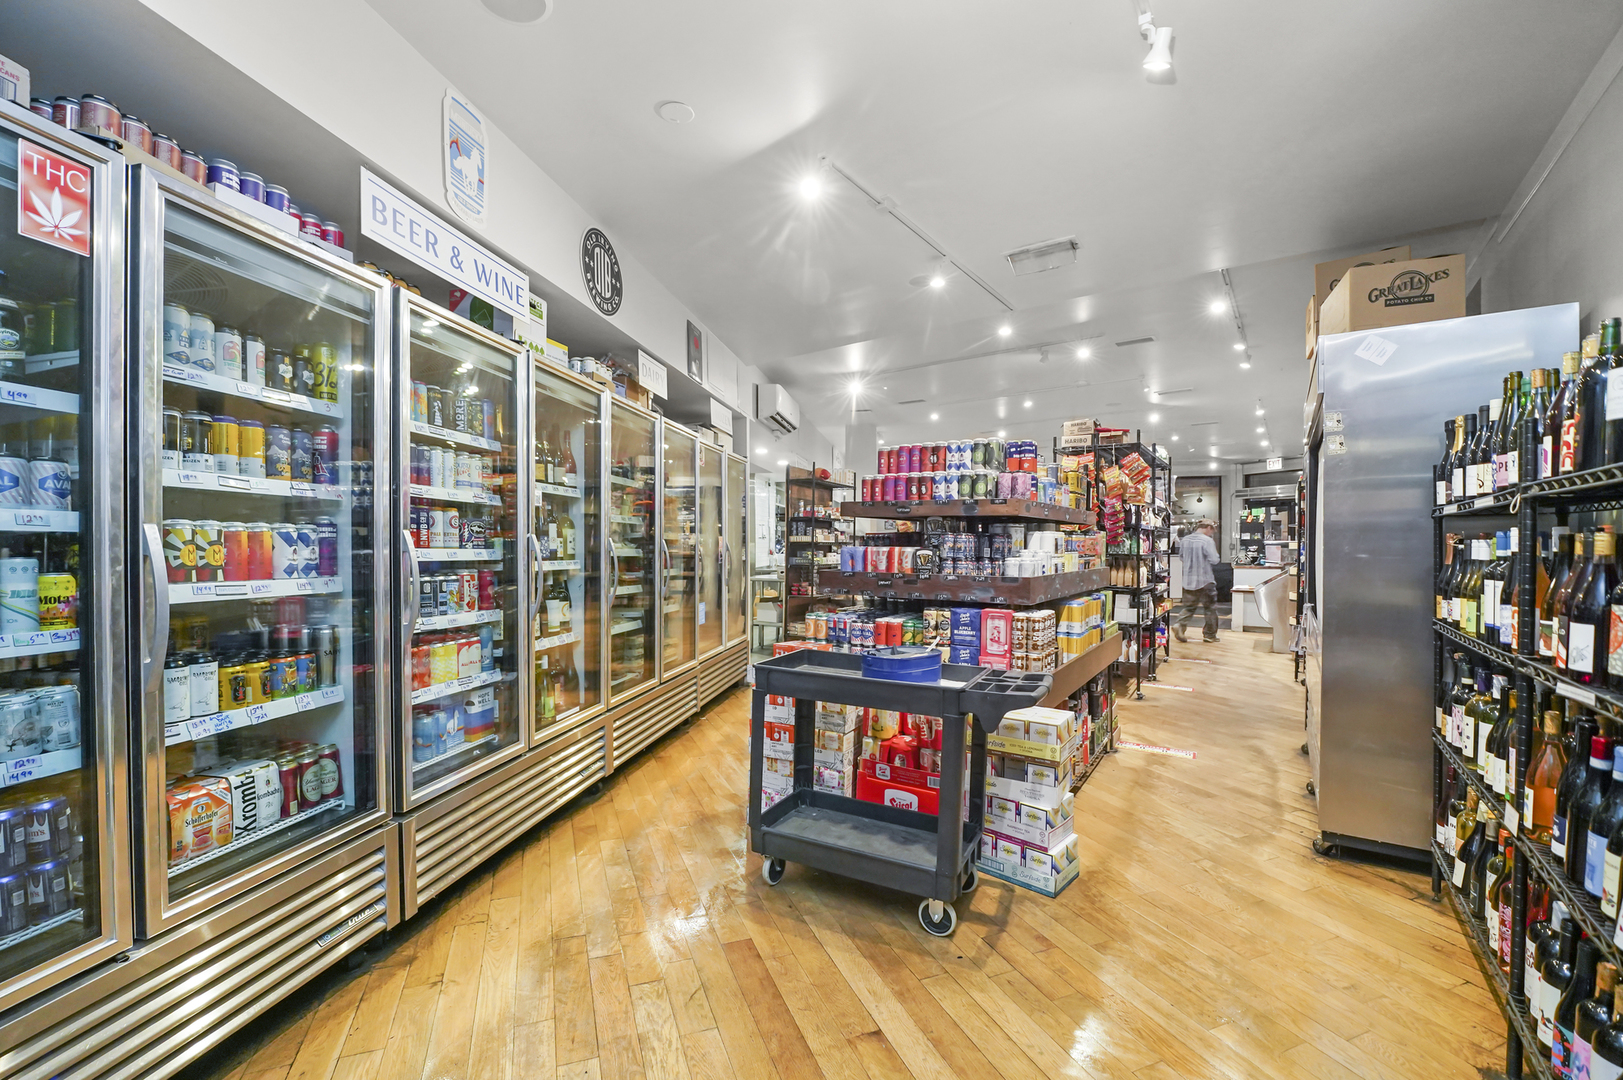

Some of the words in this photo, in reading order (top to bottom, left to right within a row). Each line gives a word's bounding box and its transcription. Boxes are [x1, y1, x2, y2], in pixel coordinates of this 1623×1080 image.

[26, 151, 86, 193] THC
[371, 193, 439, 259] BEER
[450, 245, 464, 273] &
[473, 258, 526, 308] WINE
[586, 234, 596, 249] OLD
[1368, 280, 1410, 303] GREAT
[1409, 268, 1450, 291] LAKES
[641, 362, 665, 388] DAIRY
[1268, 460, 1280, 468] EXIT
[39, 595, 71, 605] Mota
[1019, 870, 1041, 883] Surfside
